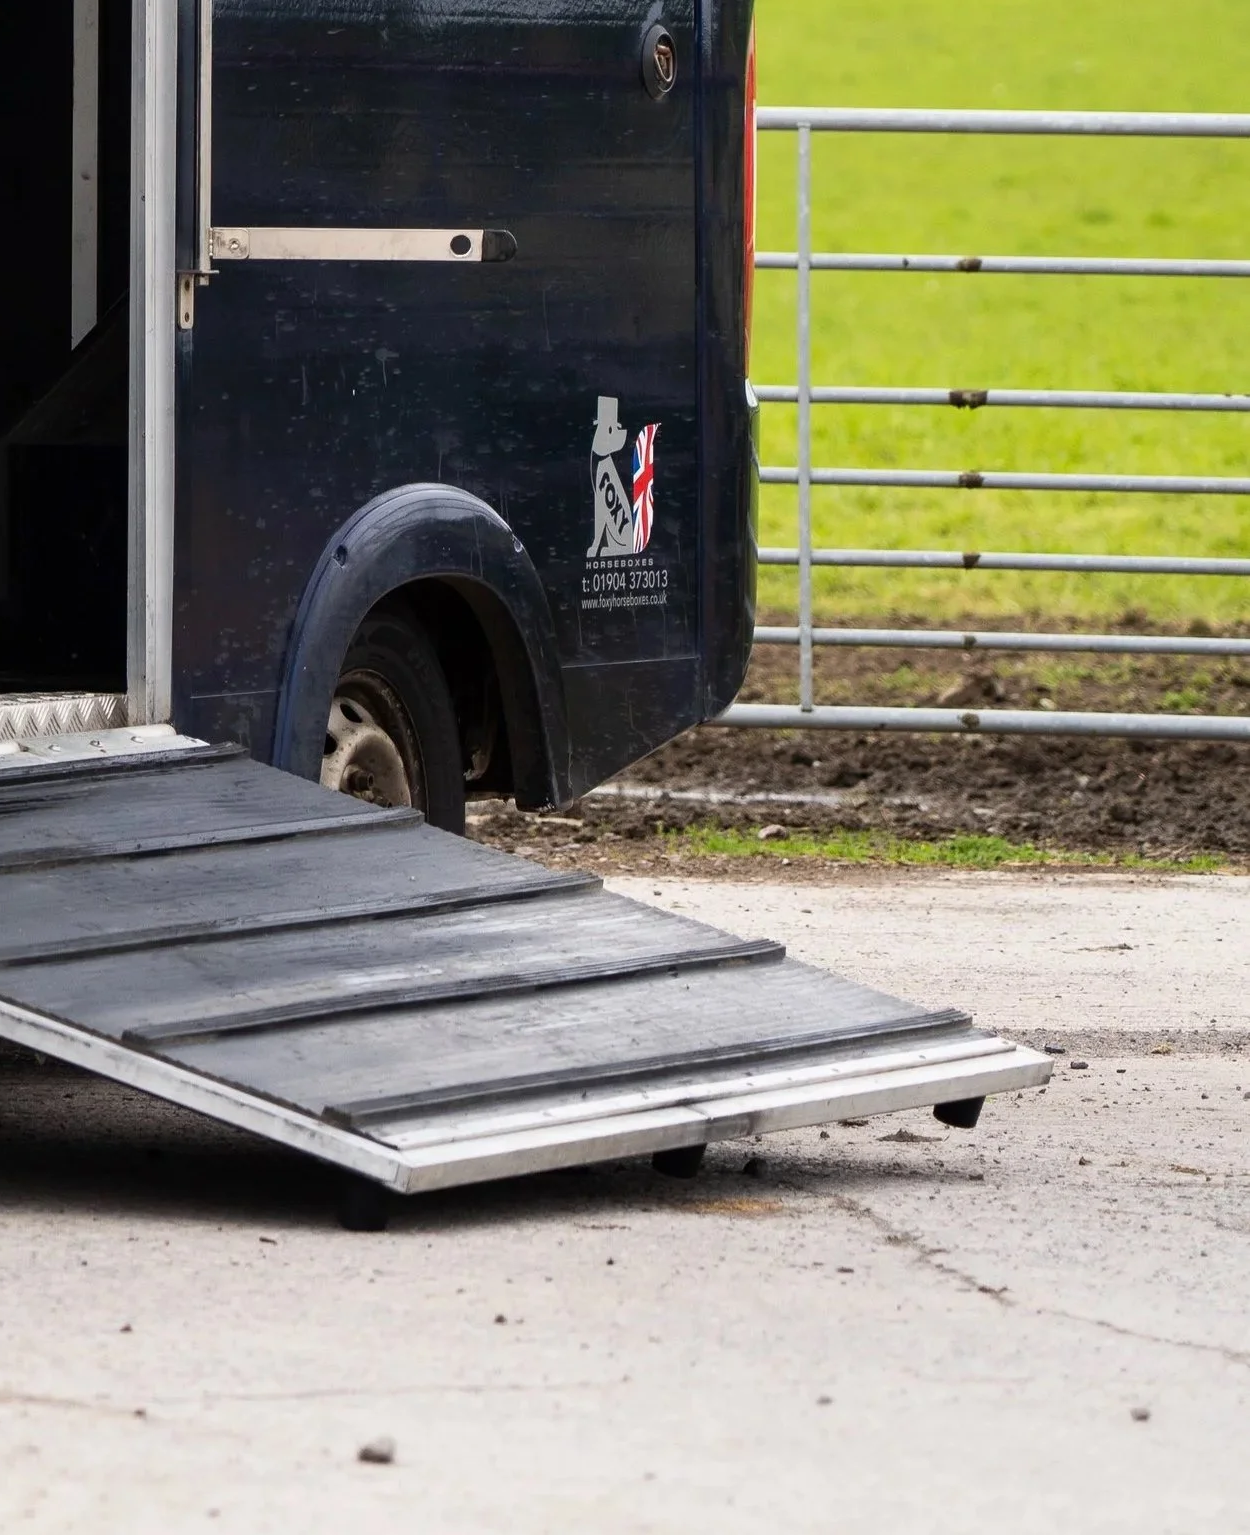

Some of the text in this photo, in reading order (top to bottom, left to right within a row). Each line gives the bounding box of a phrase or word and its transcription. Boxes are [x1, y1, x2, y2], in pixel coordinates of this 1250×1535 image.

[599, 472, 629, 534] FOXY
[586, 558, 654, 569] HORSEBOXES
[582, 570, 668, 592] t: 01904 373013
[581, 590, 667, 611] www.foxyhorseboxes.co.uk
